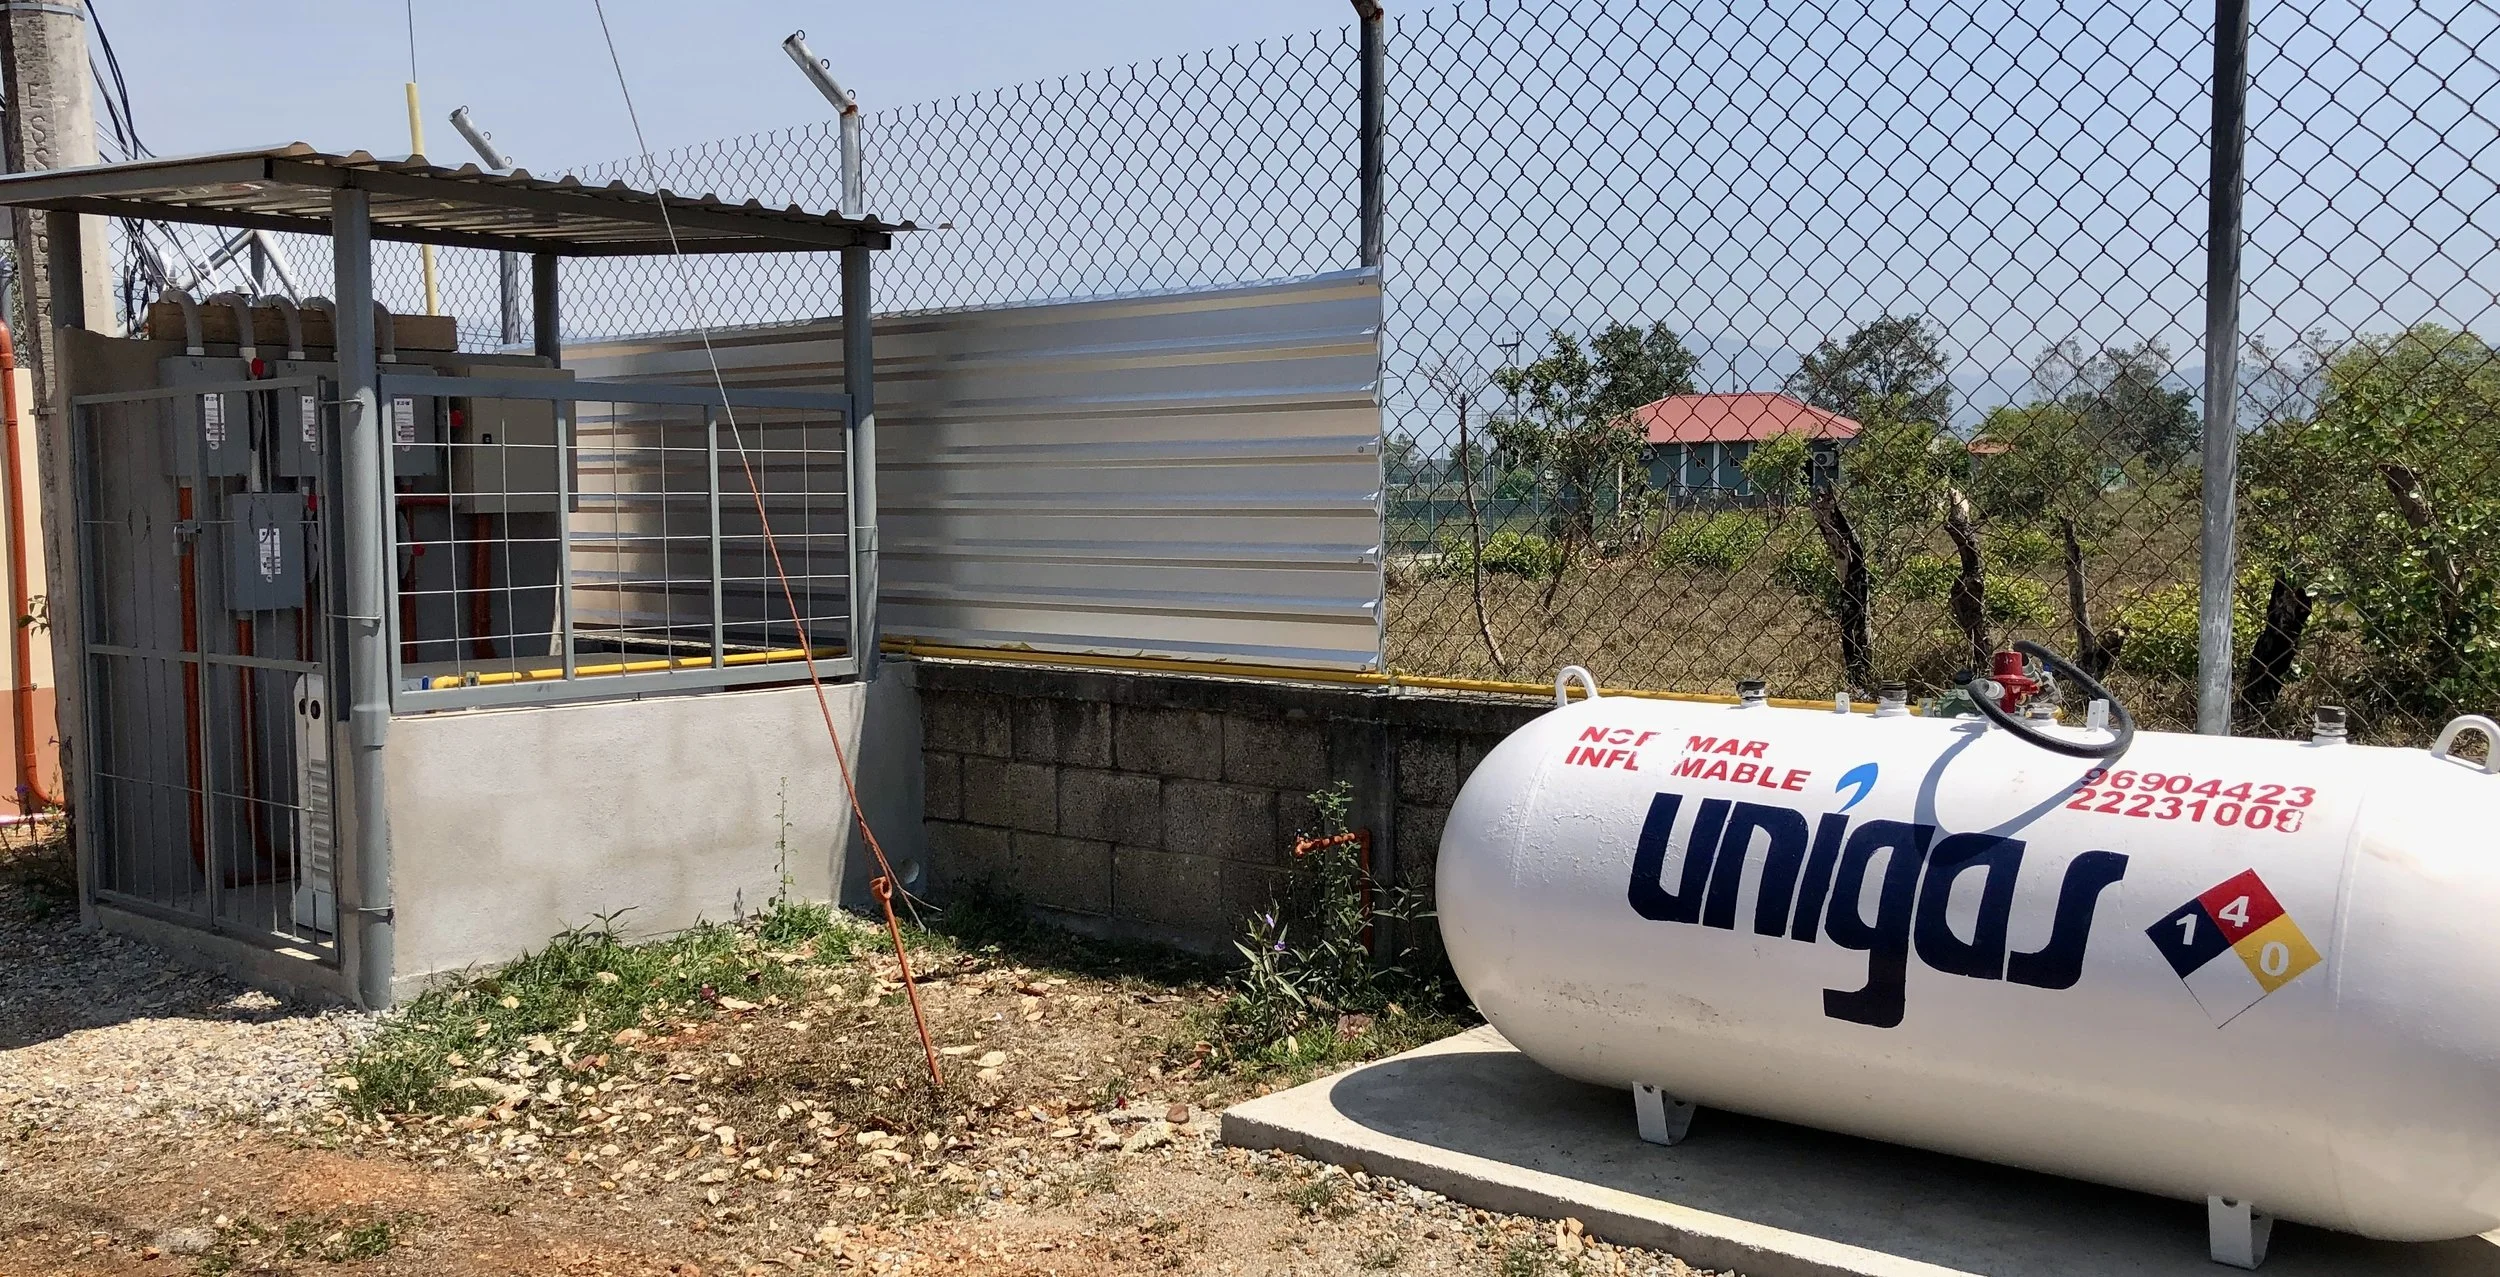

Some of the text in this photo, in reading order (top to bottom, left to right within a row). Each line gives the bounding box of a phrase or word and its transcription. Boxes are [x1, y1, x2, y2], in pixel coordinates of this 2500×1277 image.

[1564, 745, 1812, 792] INFLMABLE
[2081, 767, 2317, 808] 96904423
[1627, 762, 2130, 1029] unigas
[2218, 895, 2250, 928] 4
[2175, 913, 2198, 946] 1
[2259, 941, 2290, 977] 0
